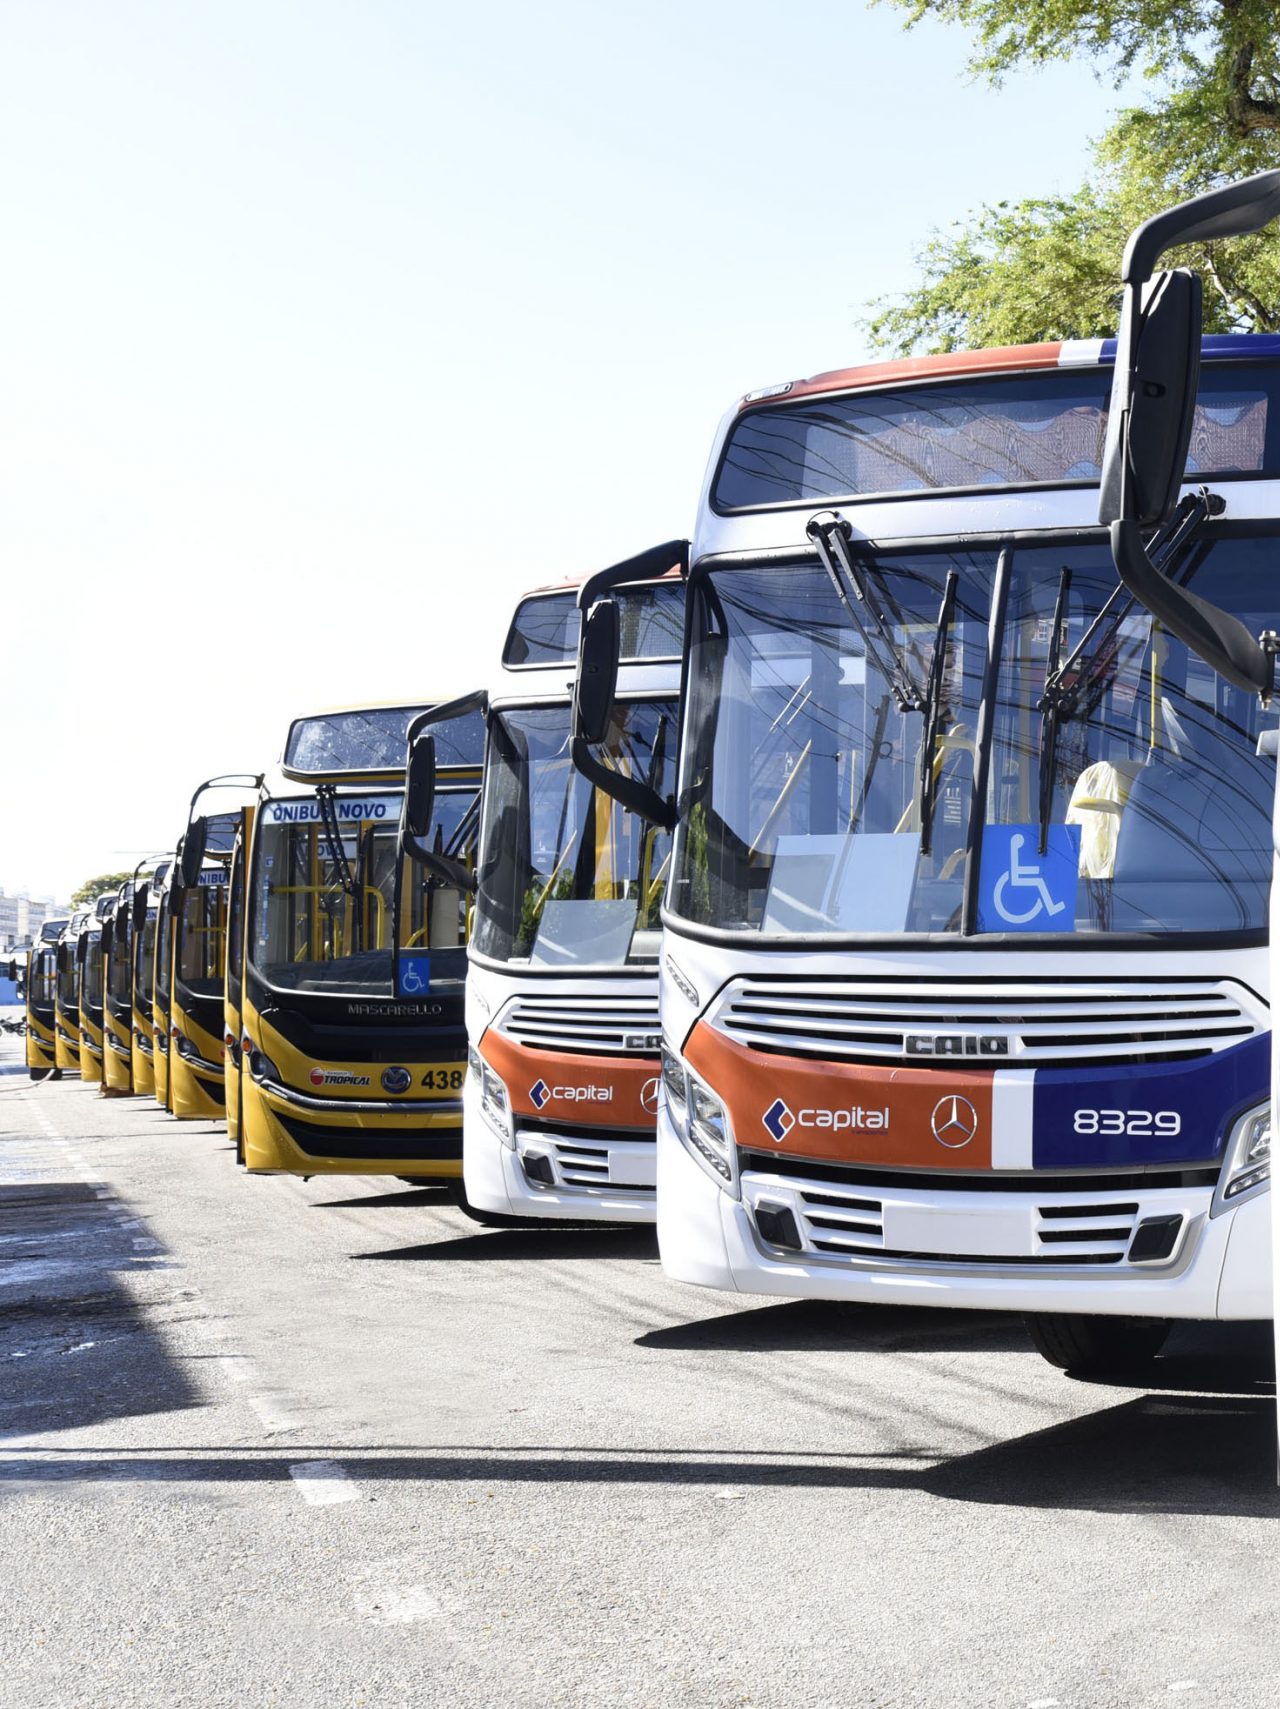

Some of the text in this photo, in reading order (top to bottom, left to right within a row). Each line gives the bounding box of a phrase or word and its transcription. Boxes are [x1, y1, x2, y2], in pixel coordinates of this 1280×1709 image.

[339, 804, 386, 818] NOVO
[348, 1004, 442, 1015] MASCARELLO
[905, 1035, 1010, 1055] CAIO
[325, 1075, 371, 1086] TROPICAL
[552, 1085, 613, 1102] capital
[798, 1106, 890, 1131] capital
[1073, 1109, 1182, 1136] 8329
